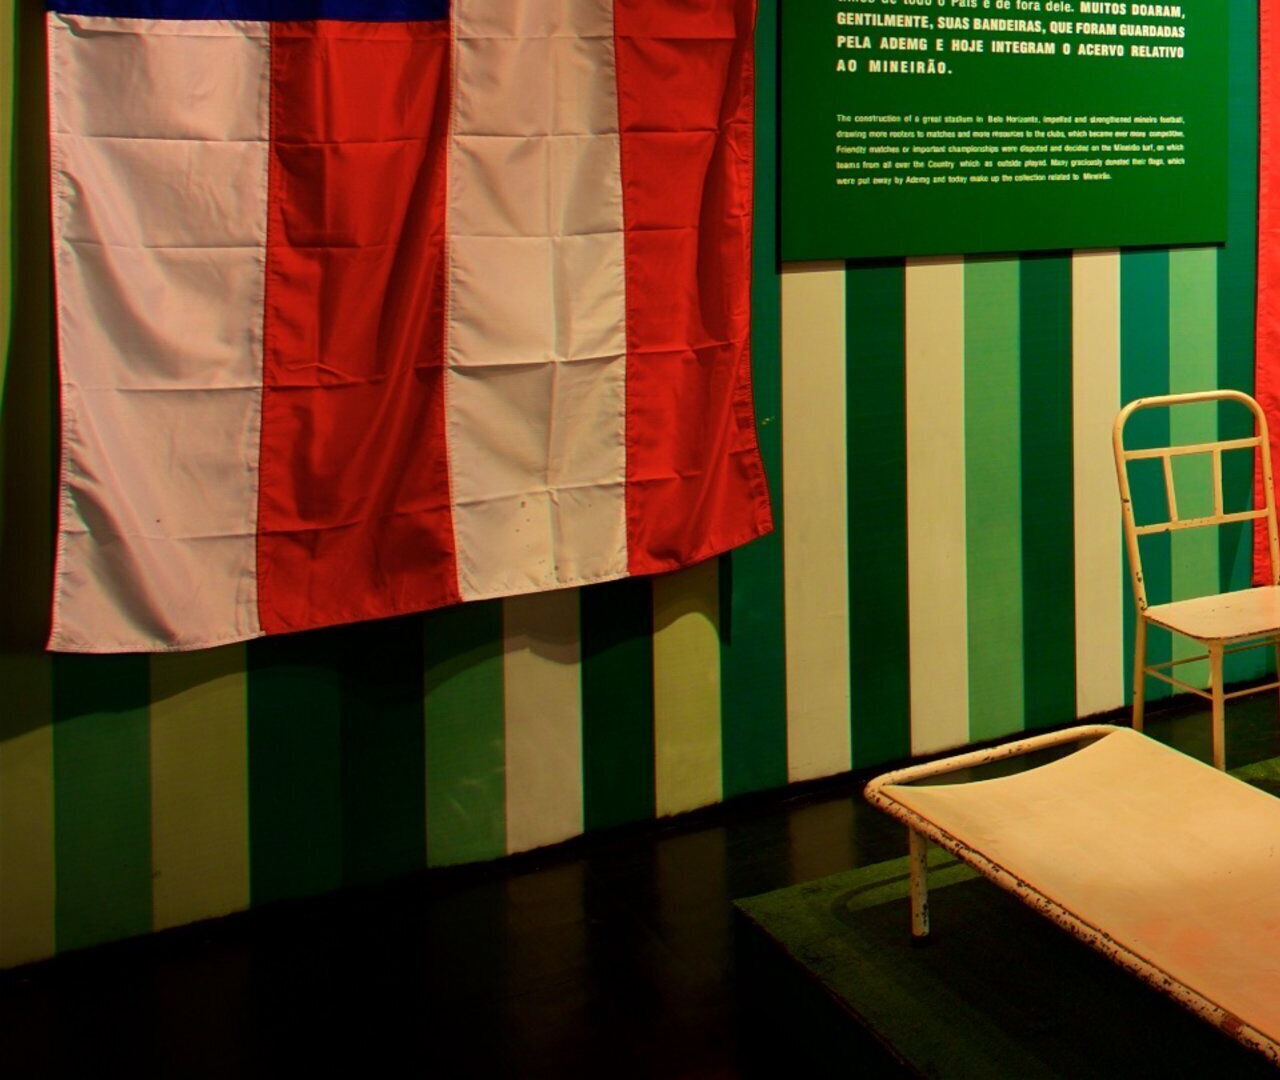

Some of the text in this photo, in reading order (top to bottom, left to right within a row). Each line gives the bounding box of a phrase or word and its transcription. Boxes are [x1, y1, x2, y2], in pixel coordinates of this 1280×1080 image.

[982, 0, 989, 8] e
[1045, 0, 1073, 12] dele.
[1079, 1, 1125, 15] MUITOS
[1130, 4, 1184, 19] DOARAM,
[836, 12, 1184, 38] GENTILMENTE, SUAS BANDEIRAS, QUE FORAM GUARDADAS
[837, 35, 1183, 58] PELA ADEMG E HOJE INTEGRAM O ACERVO RELATIVO
[836, 58, 951, 74] AO MINEIRÃO.
